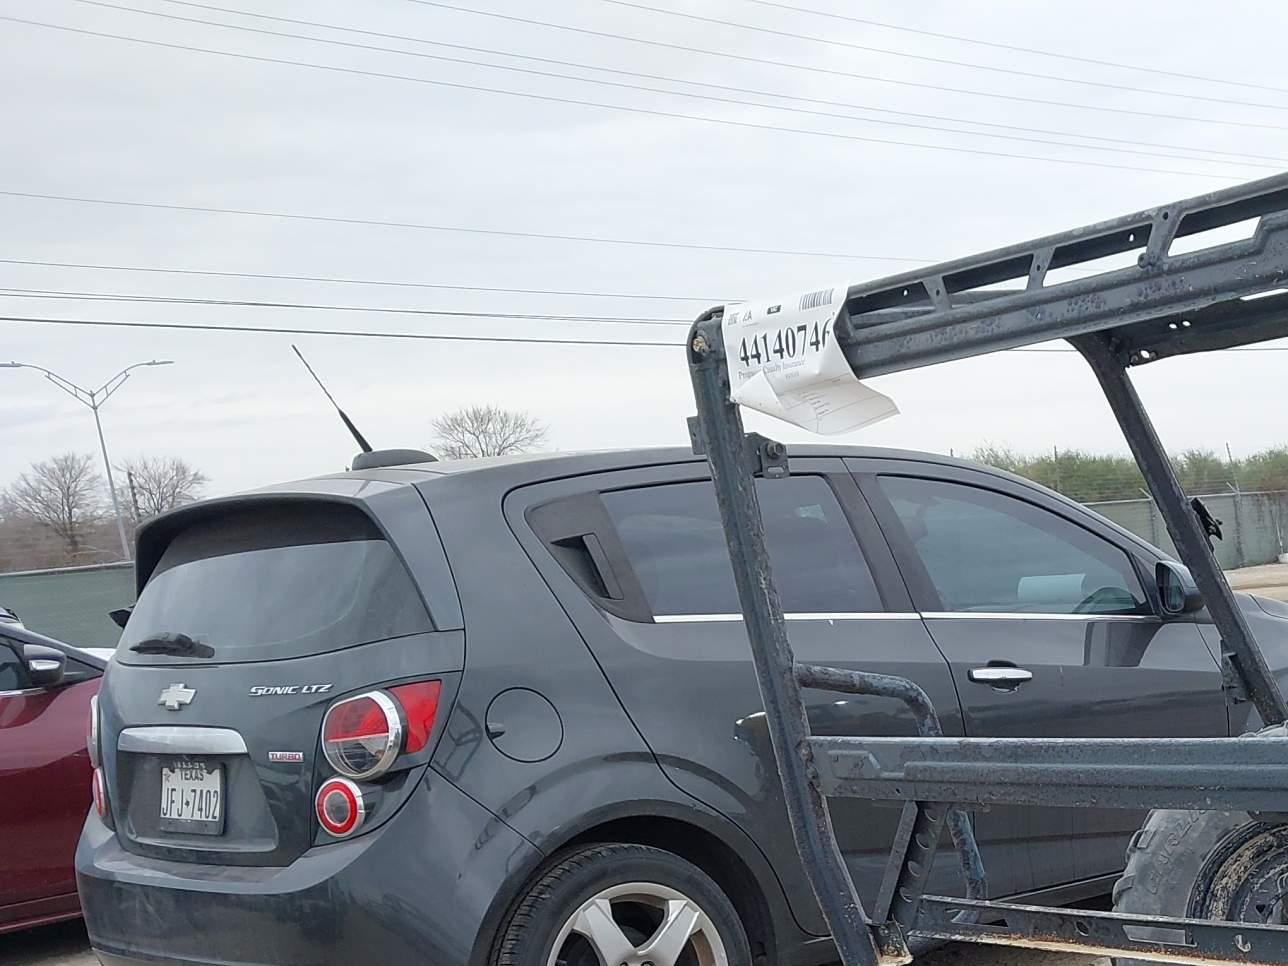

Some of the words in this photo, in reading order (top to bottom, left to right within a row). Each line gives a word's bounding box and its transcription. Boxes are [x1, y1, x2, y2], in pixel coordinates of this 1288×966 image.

[248, 686, 300, 696] SONIC
[301, 684, 333, 693] LTZ
[270, 753, 302, 761] TURBO
[181, 768, 204, 781] TEXAS
